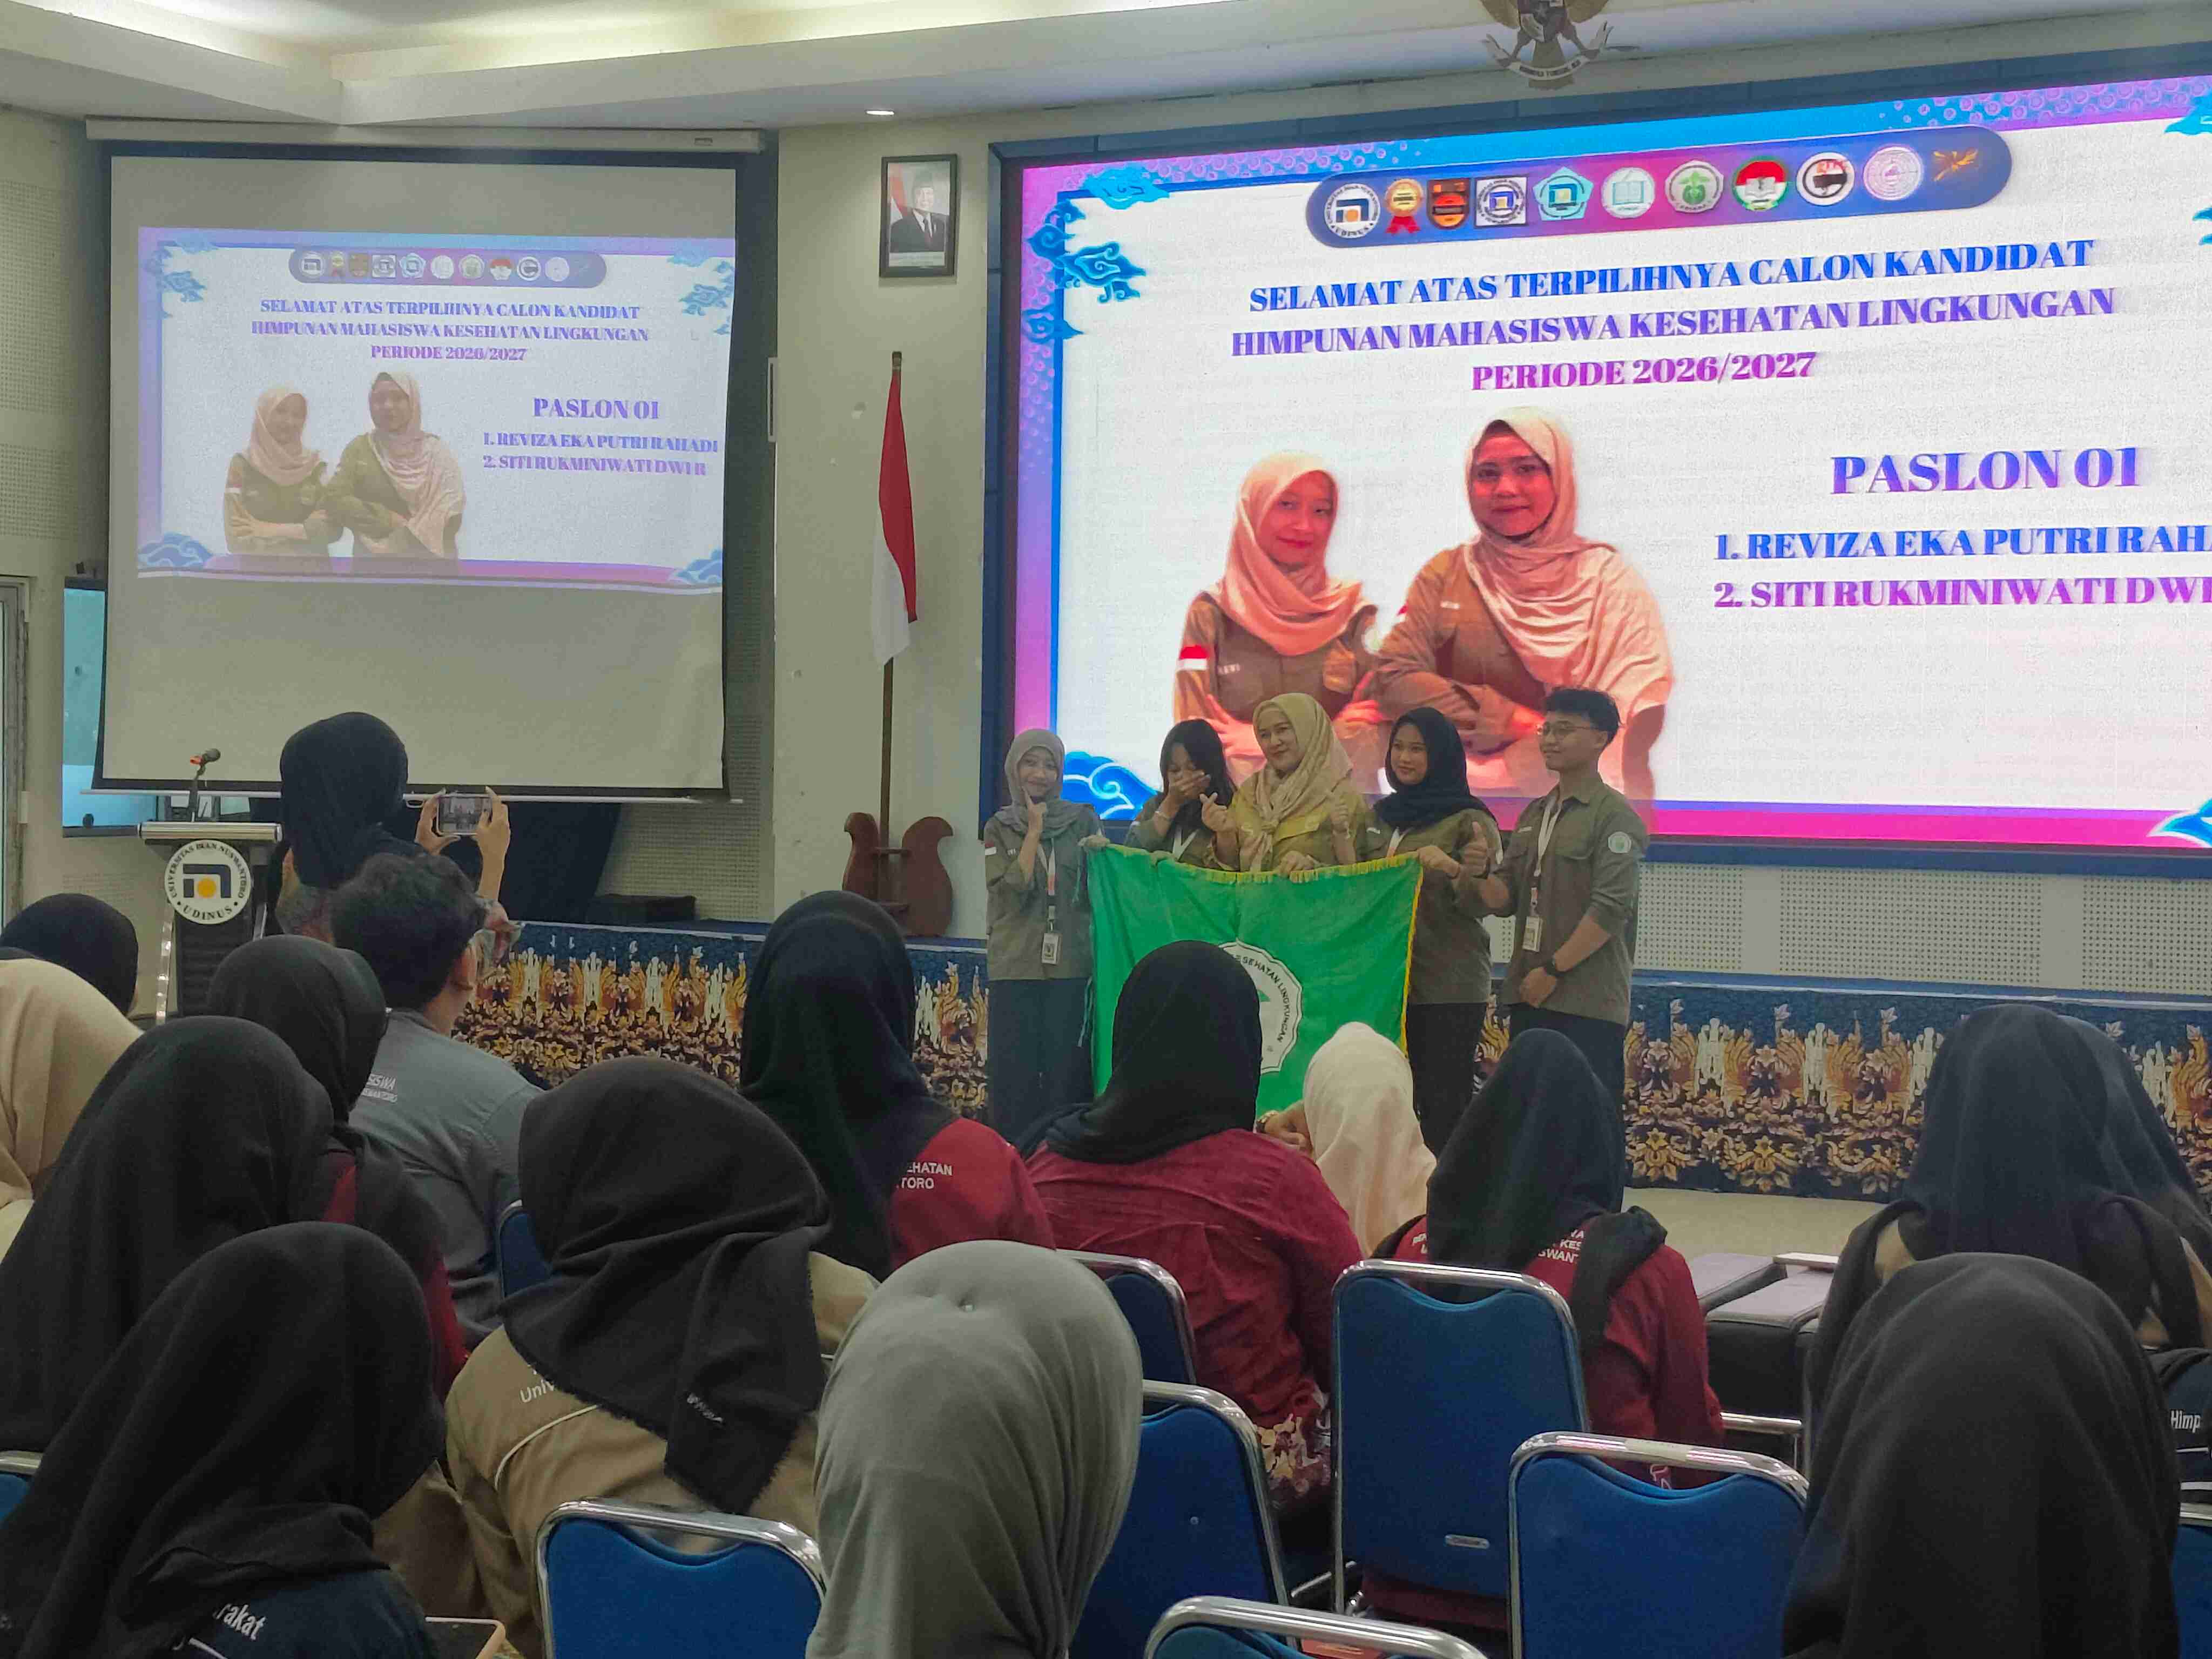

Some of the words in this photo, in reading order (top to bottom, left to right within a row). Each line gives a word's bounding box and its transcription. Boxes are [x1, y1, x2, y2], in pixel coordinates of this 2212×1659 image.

[1250, 280, 1403, 312] SELAMAT
[1409, 276, 1497, 304] ATAS
[1505, 262, 1741, 299] TERPILIHNYA
[1749, 252, 1877, 286] CALON
[1884, 240, 2094, 278] KANDIDAT
[260, 299, 337, 313] SELAMAT
[340, 301, 383, 314] ATAS
[386, 302, 494, 316] TERPILIHNYA
[496, 304, 551, 317] CALON
[554, 305, 640, 319] KANDIDAT
[251, 320, 338, 336] HIMPUNAN
[341, 323, 441, 338] MAHASISWA
[443, 325, 541, 339] KESEHATAN
[543, 327, 649, 342] LINGKUNGAN
[1231, 325, 1402, 356] HIMPUNAN
[1408, 314, 1621, 348] MAHASISWA
[1628, 302, 1850, 338] KESEHATAN
[1857, 288, 2115, 327] LINGKUNGAN
[371, 345, 442, 359] PERIODE
[445, 347, 528, 361] 2026/2027
[1471, 360, 1625, 390] PERIODE
[1632, 352, 1817, 385] 2026/2027
[532, 397, 629, 419] PASLON
[633, 401, 659, 420] 01
[483, 433, 495, 445] 1.
[497, 433, 558, 447] REVIZA
[560, 434, 595, 448] EKA
[597, 435, 648, 450] PUTRI
[650, 436, 718, 453] RAHADI
[483, 455, 497, 468] 2.
[499, 455, 532, 469] SITI
[535, 456, 651, 473] RUKMINIWATI
[655, 460, 692, 475] DWI
[694, 462, 706, 476] R
[1830, 449, 2062, 495] PASLON
[2074, 447, 2140, 488] 01
[1714, 534, 1743, 560] 1.
[1747, 531, 1887, 559] REVIZA
[1894, 529, 1976, 556] EKA
[1983, 527, 2107, 555] PUTRI
[2117, 524, 2212, 553] RAH
[1714, 582, 1743, 608] 2.
[1751, 581, 1826, 608] SITI
[1832, 578, 2116, 606] RUKMINIWATI
[2126, 576, 2212, 604] DWI
[183, 904, 233, 920] UDINUS
[896, 1176, 935, 1190] TORO
[213, 1603, 267, 1641] rakat
